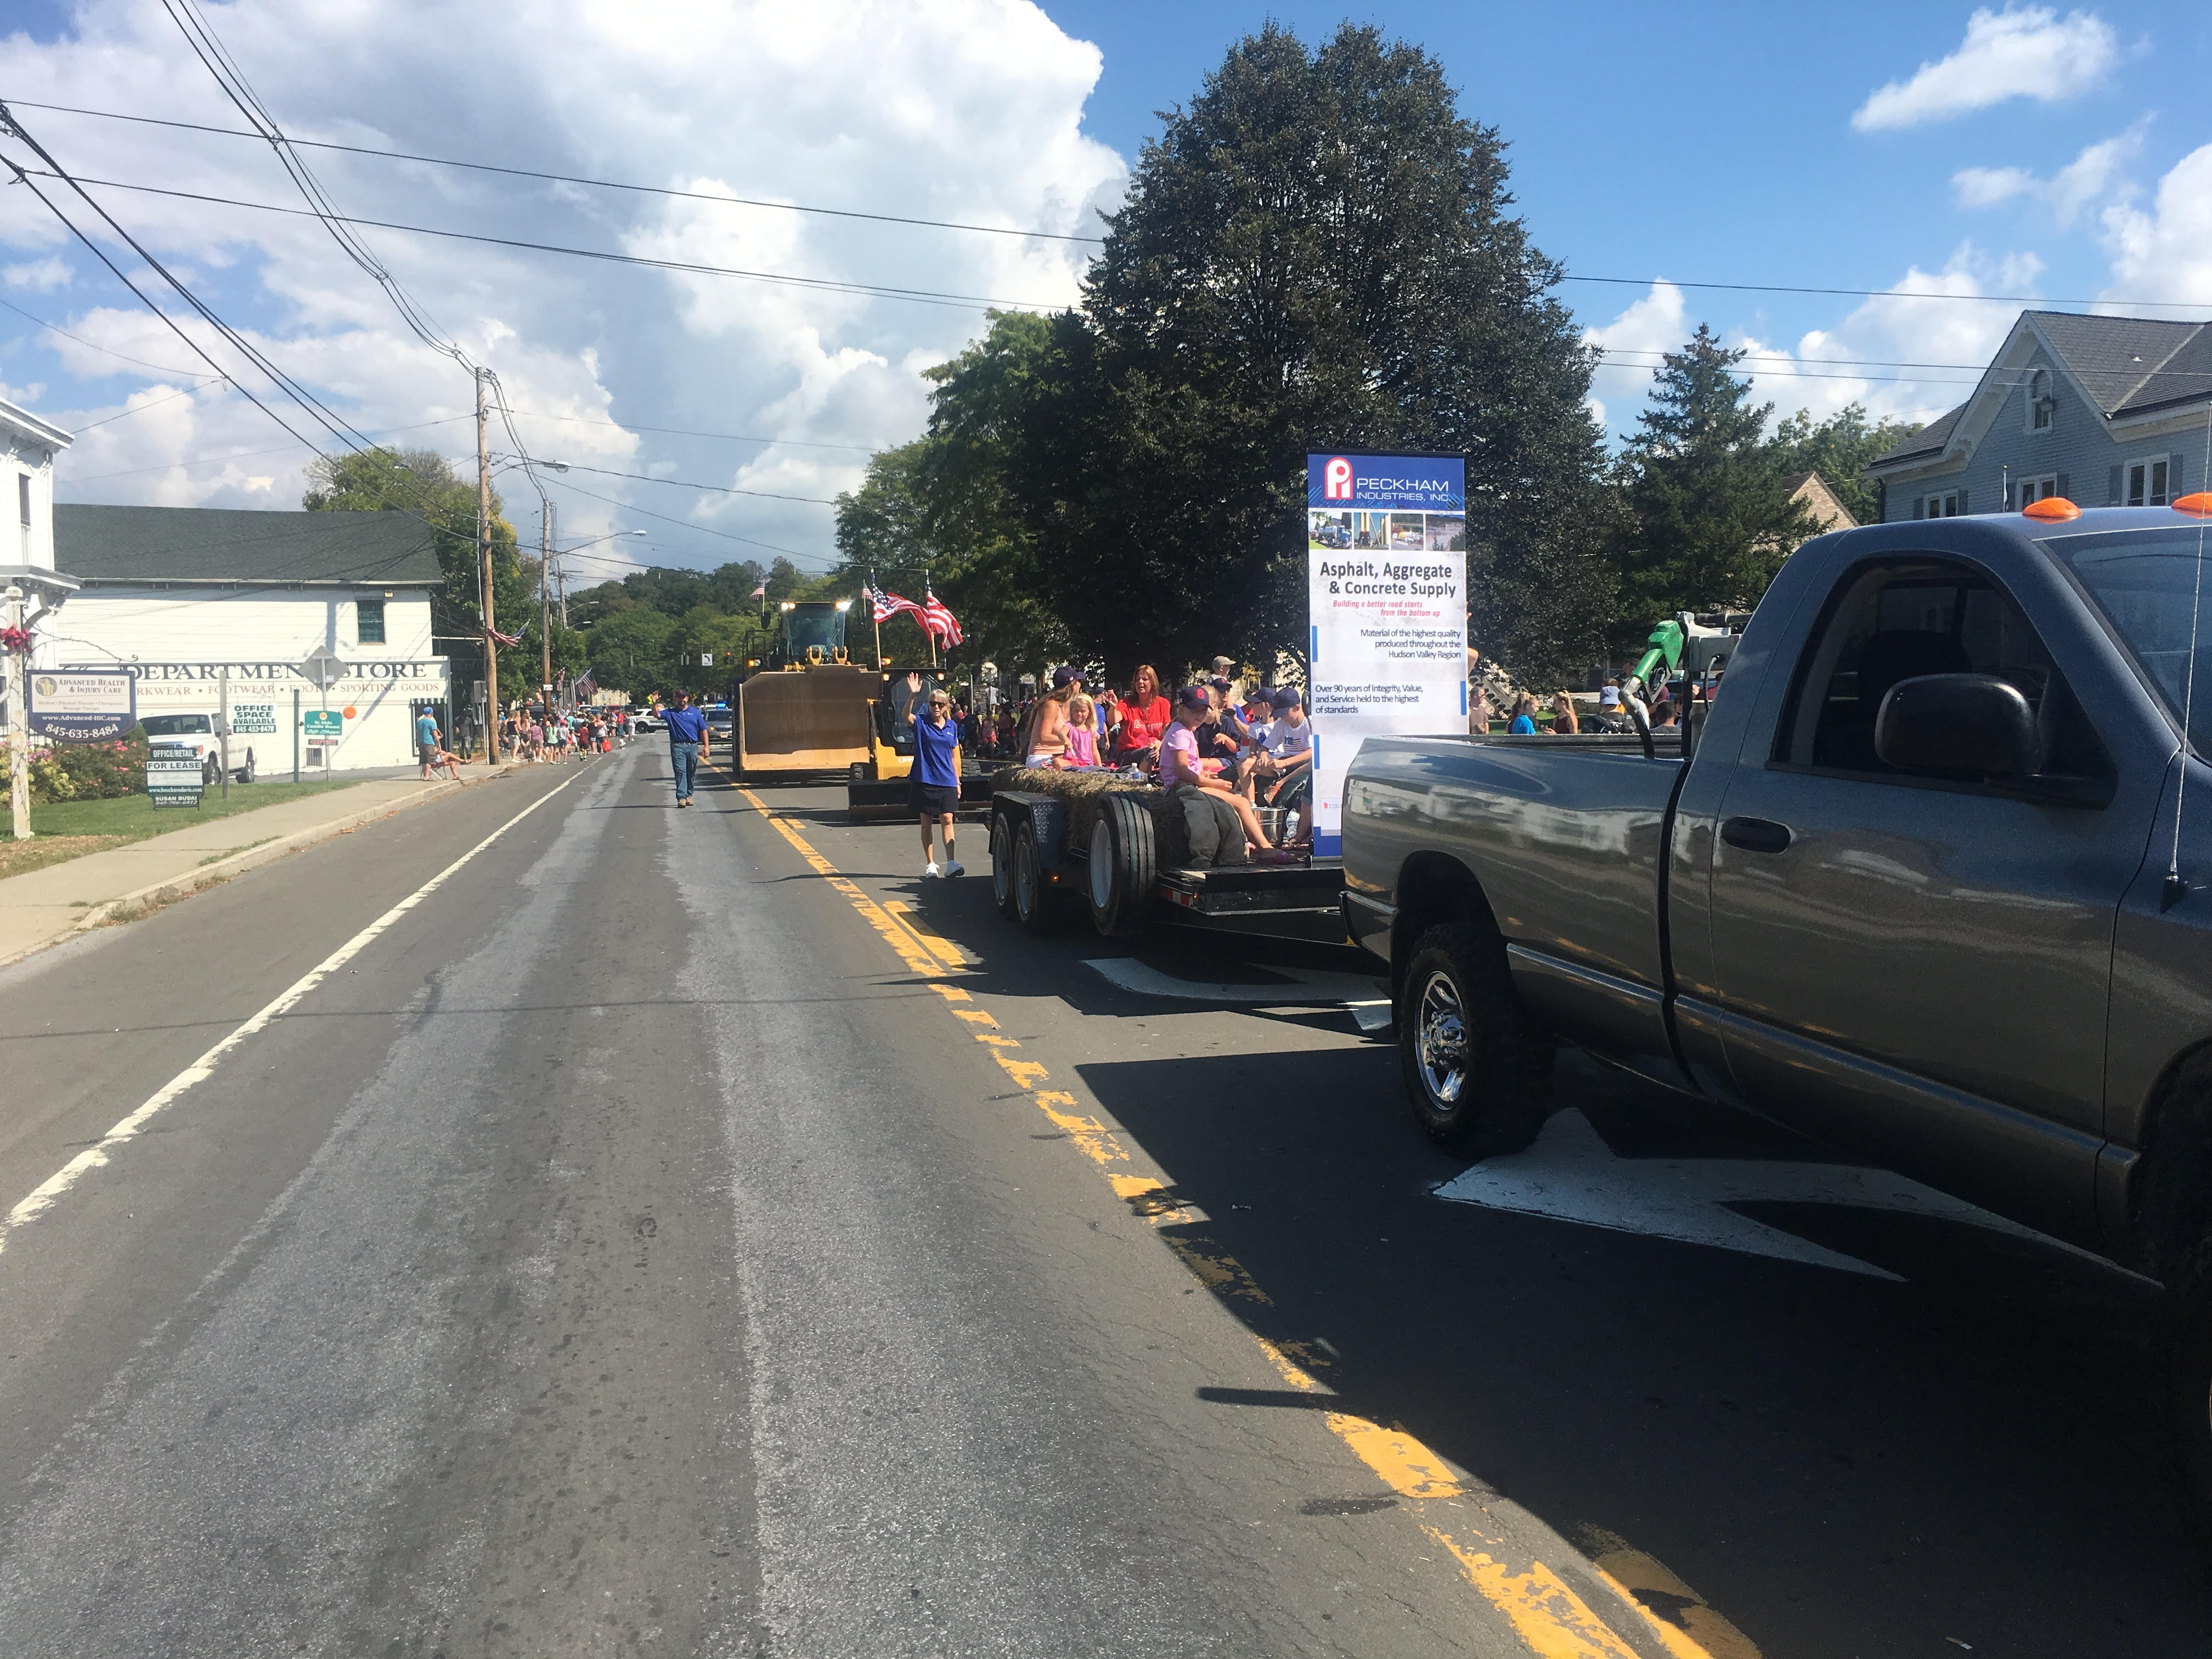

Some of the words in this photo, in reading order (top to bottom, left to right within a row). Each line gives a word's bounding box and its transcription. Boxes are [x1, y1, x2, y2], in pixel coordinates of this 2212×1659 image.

[1357, 478, 1449, 492] PECKHAM
[1357, 492, 1425, 501] INDUSTRIES,
[1430, 494, 1452, 502] INC.
[1320, 561, 1378, 579] Asphalt,
[1383, 562, 1452, 580] Aggregate
[1329, 581, 1340, 594] &
[1345, 582, 1406, 594] Concrete
[1410, 582, 1456, 598] Supply
[1333, 600, 1359, 608] Building
[1391, 629, 1398, 637] of
[1399, 629, 1411, 637] the
[1412, 629, 1436, 639] highest
[1437, 630, 1461, 639] quality
[1375, 640, 1408, 648] produced
[1409, 640, 1448, 649] throughout
[1417, 650, 1436, 659] Valley
[1437, 651, 1461, 659] Region
[119, 663, 304, 680] DEPARTMEN
[137, 687, 191, 695] RKWEAR
[340, 684, 396, 693] SPORTING
[401, 684, 439, 692] GOODS
[1372, 684, 1401, 693] Integrity,
[1402, 684, 1423, 693] Value,
[1356, 695, 1372, 703] held
[1381, 695, 1393, 703] the
[1395, 695, 1419, 704] highest
[46, 723, 119, 738] 845-635-8484
[153, 749, 194, 758] OFFICE/RETAIL
